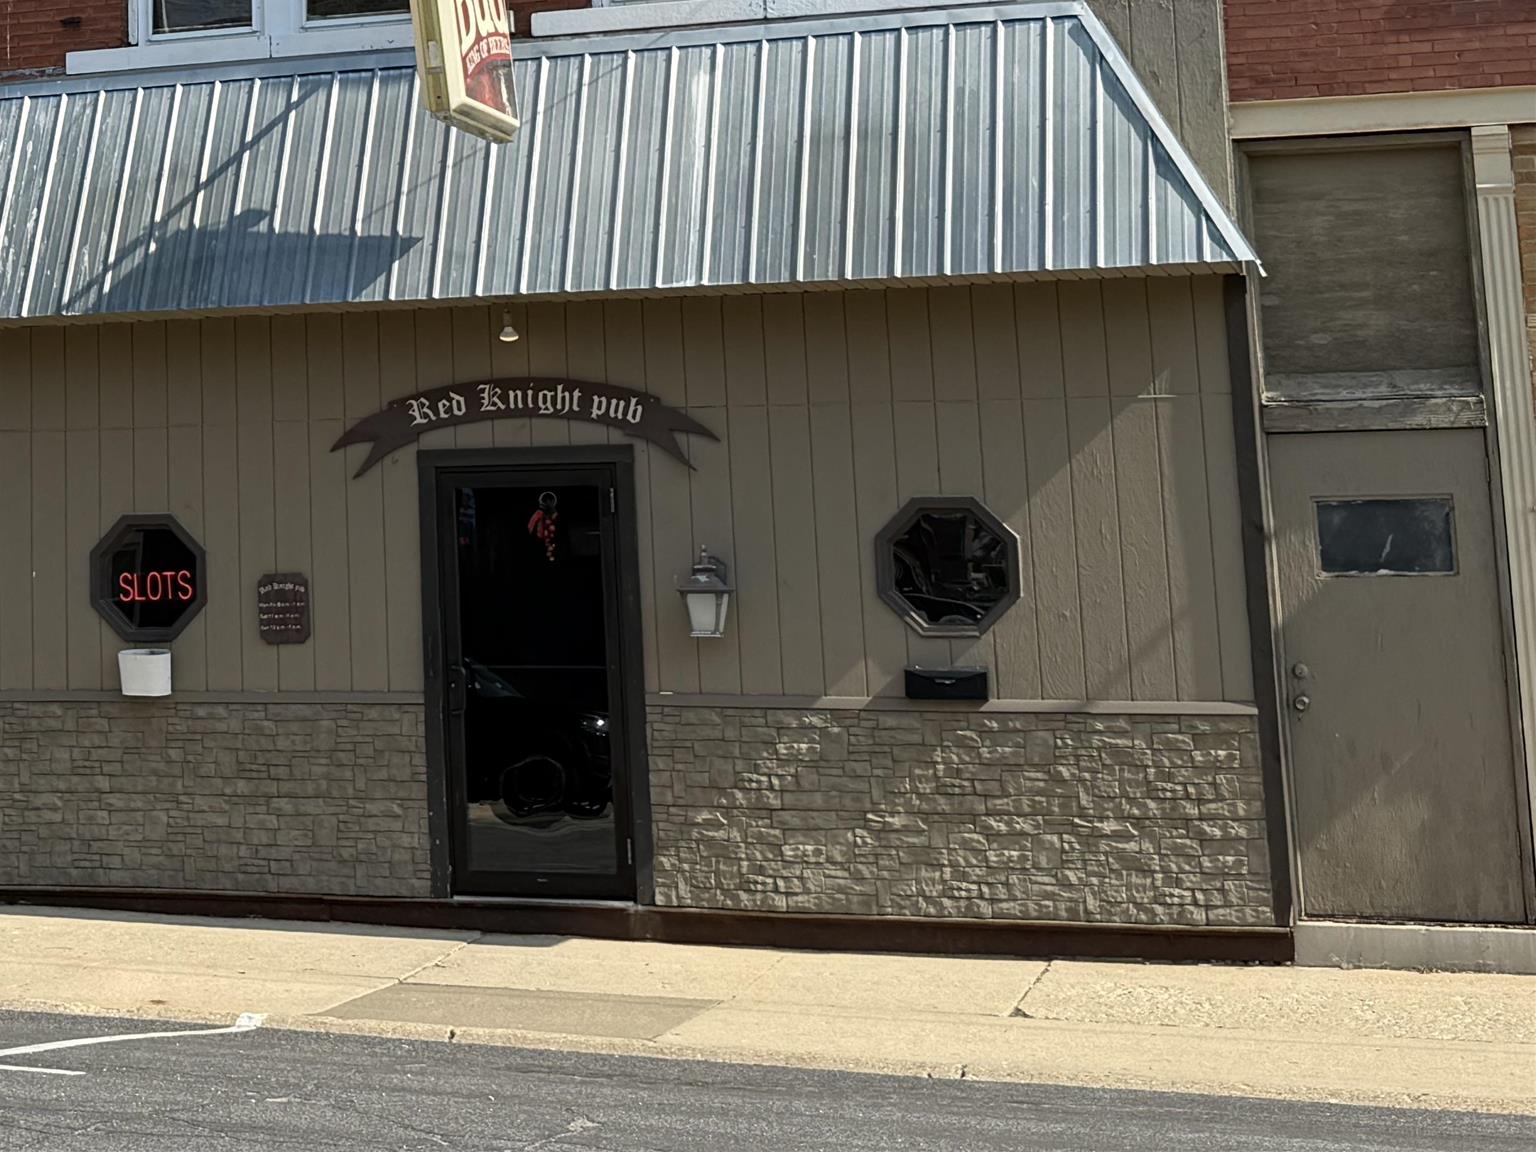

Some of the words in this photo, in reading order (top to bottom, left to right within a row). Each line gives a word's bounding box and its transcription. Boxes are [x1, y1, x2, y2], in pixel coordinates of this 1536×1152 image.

[406, 391, 467, 427] Red
[477, 382, 582, 415] Knight
[591, 394, 644, 424] pub
[118, 570, 194, 602] SLOTS
